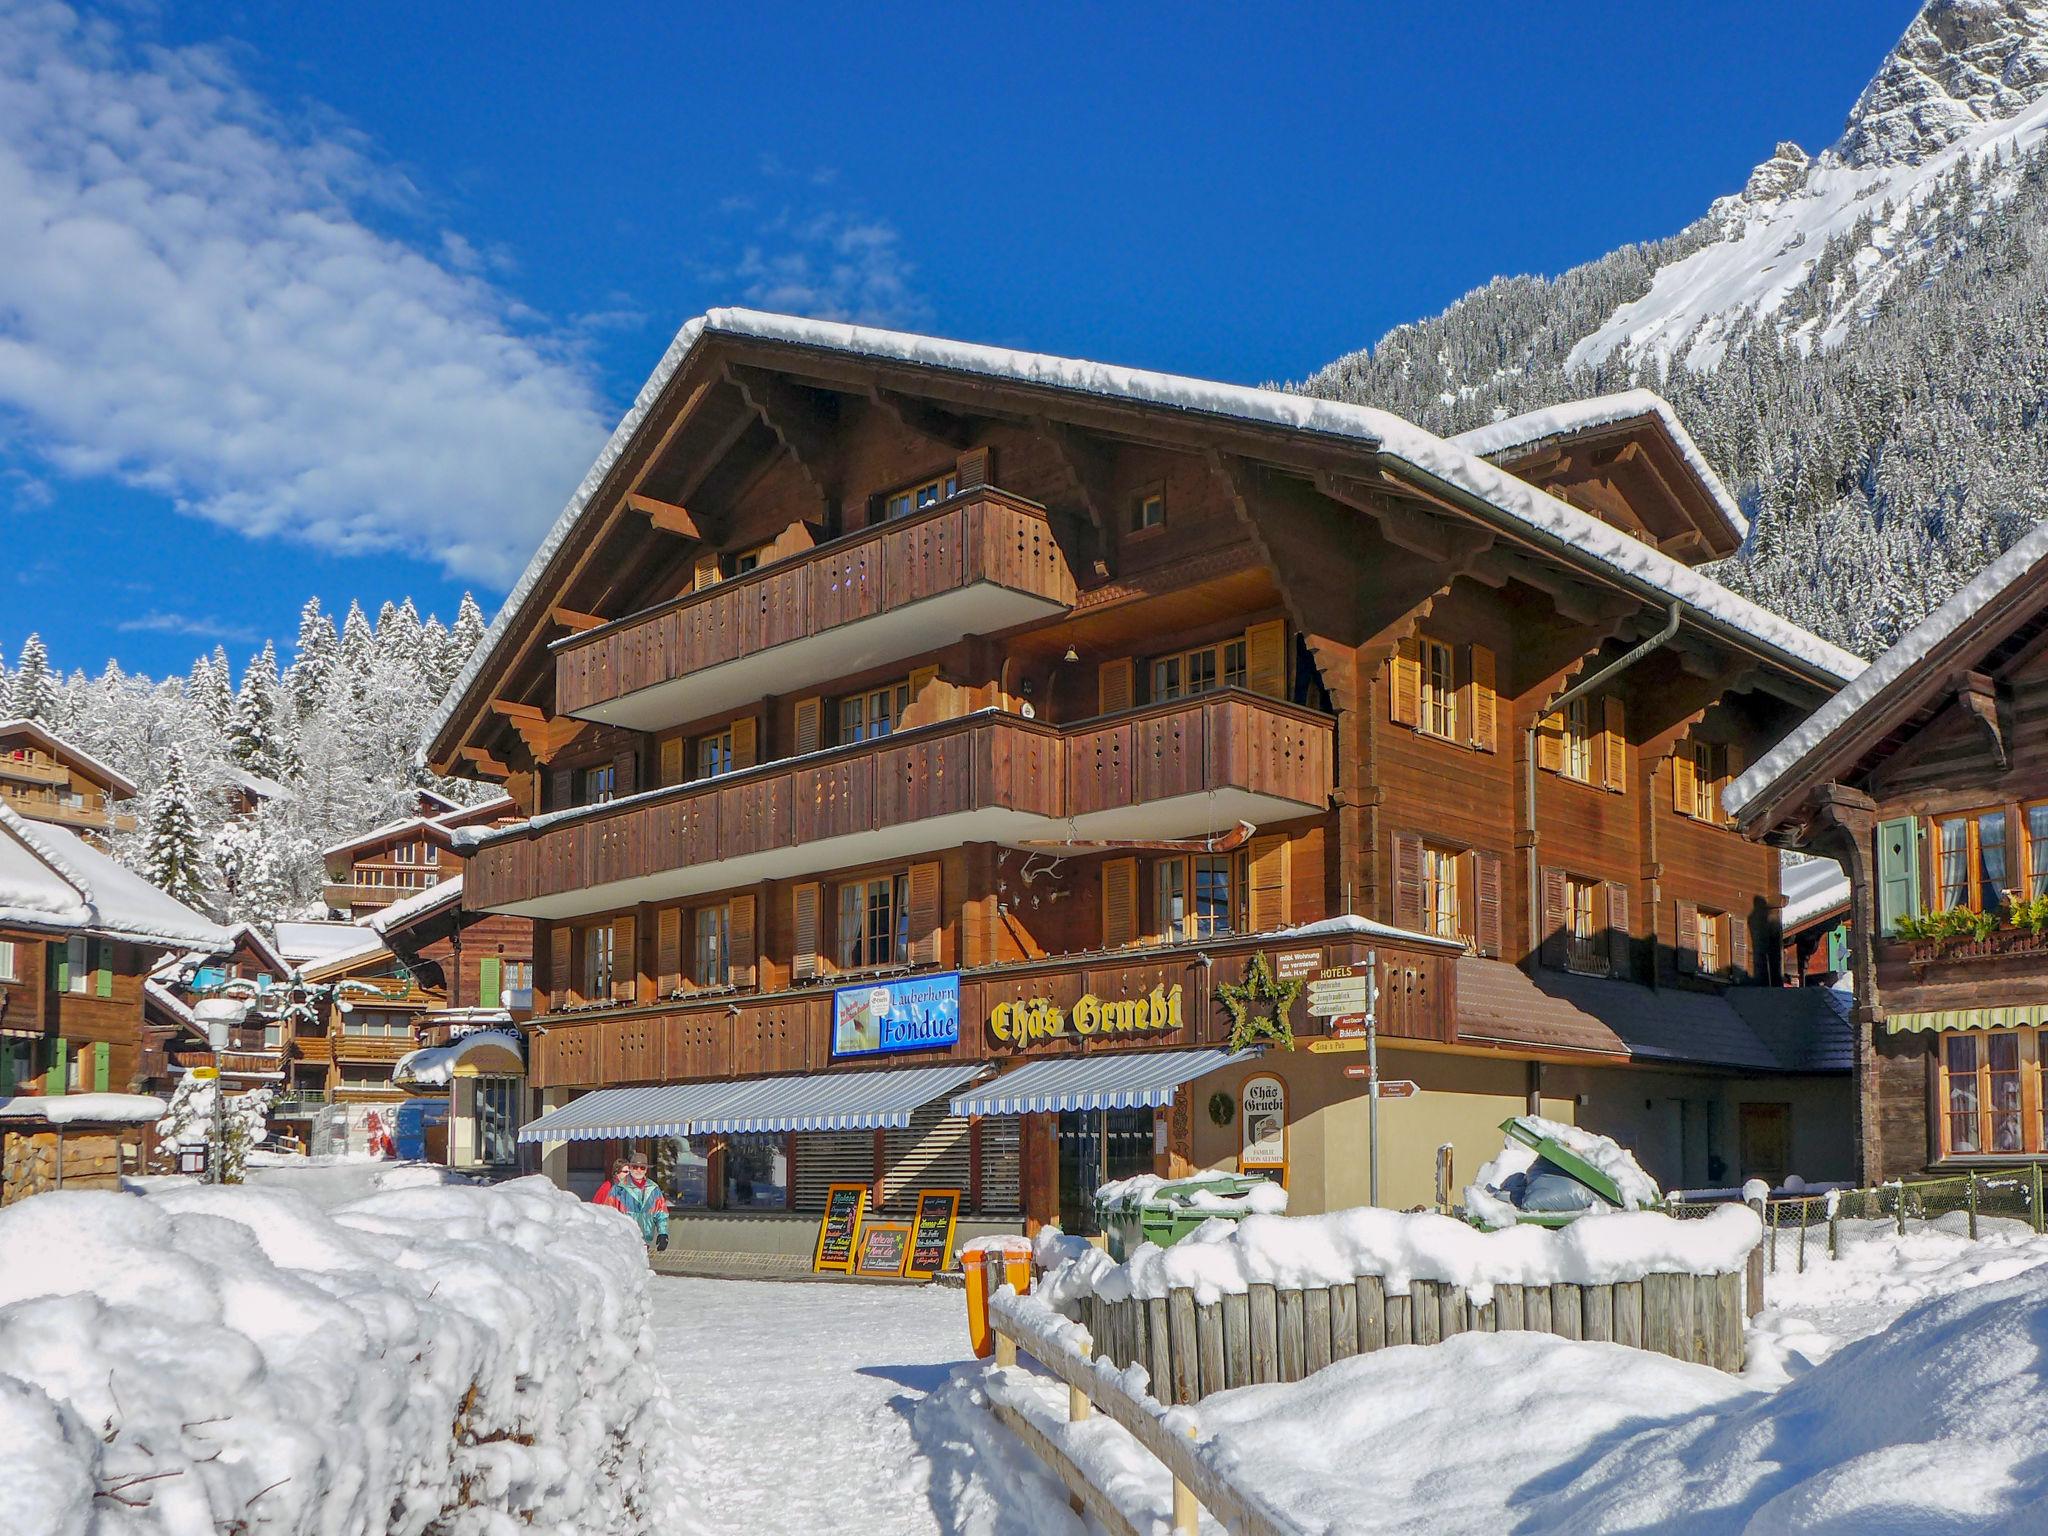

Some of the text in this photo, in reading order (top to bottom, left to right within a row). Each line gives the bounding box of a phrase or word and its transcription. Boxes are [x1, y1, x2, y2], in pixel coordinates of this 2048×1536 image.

[1294, 952, 1320, 961] Wohnung
[1290, 960, 1318, 969] vermieten
[1320, 966, 1353, 979] HOTELS
[892, 984, 954, 1006] Lauberhorn
[1316, 991, 1350, 1002] Jungfraublick
[991, 983, 1184, 1048] Chäs Gruebi
[885, 1009, 954, 1043] Fondue
[1250, 1085, 1278, 1101] Chäs
[1244, 1098, 1283, 1112] Gruebi
